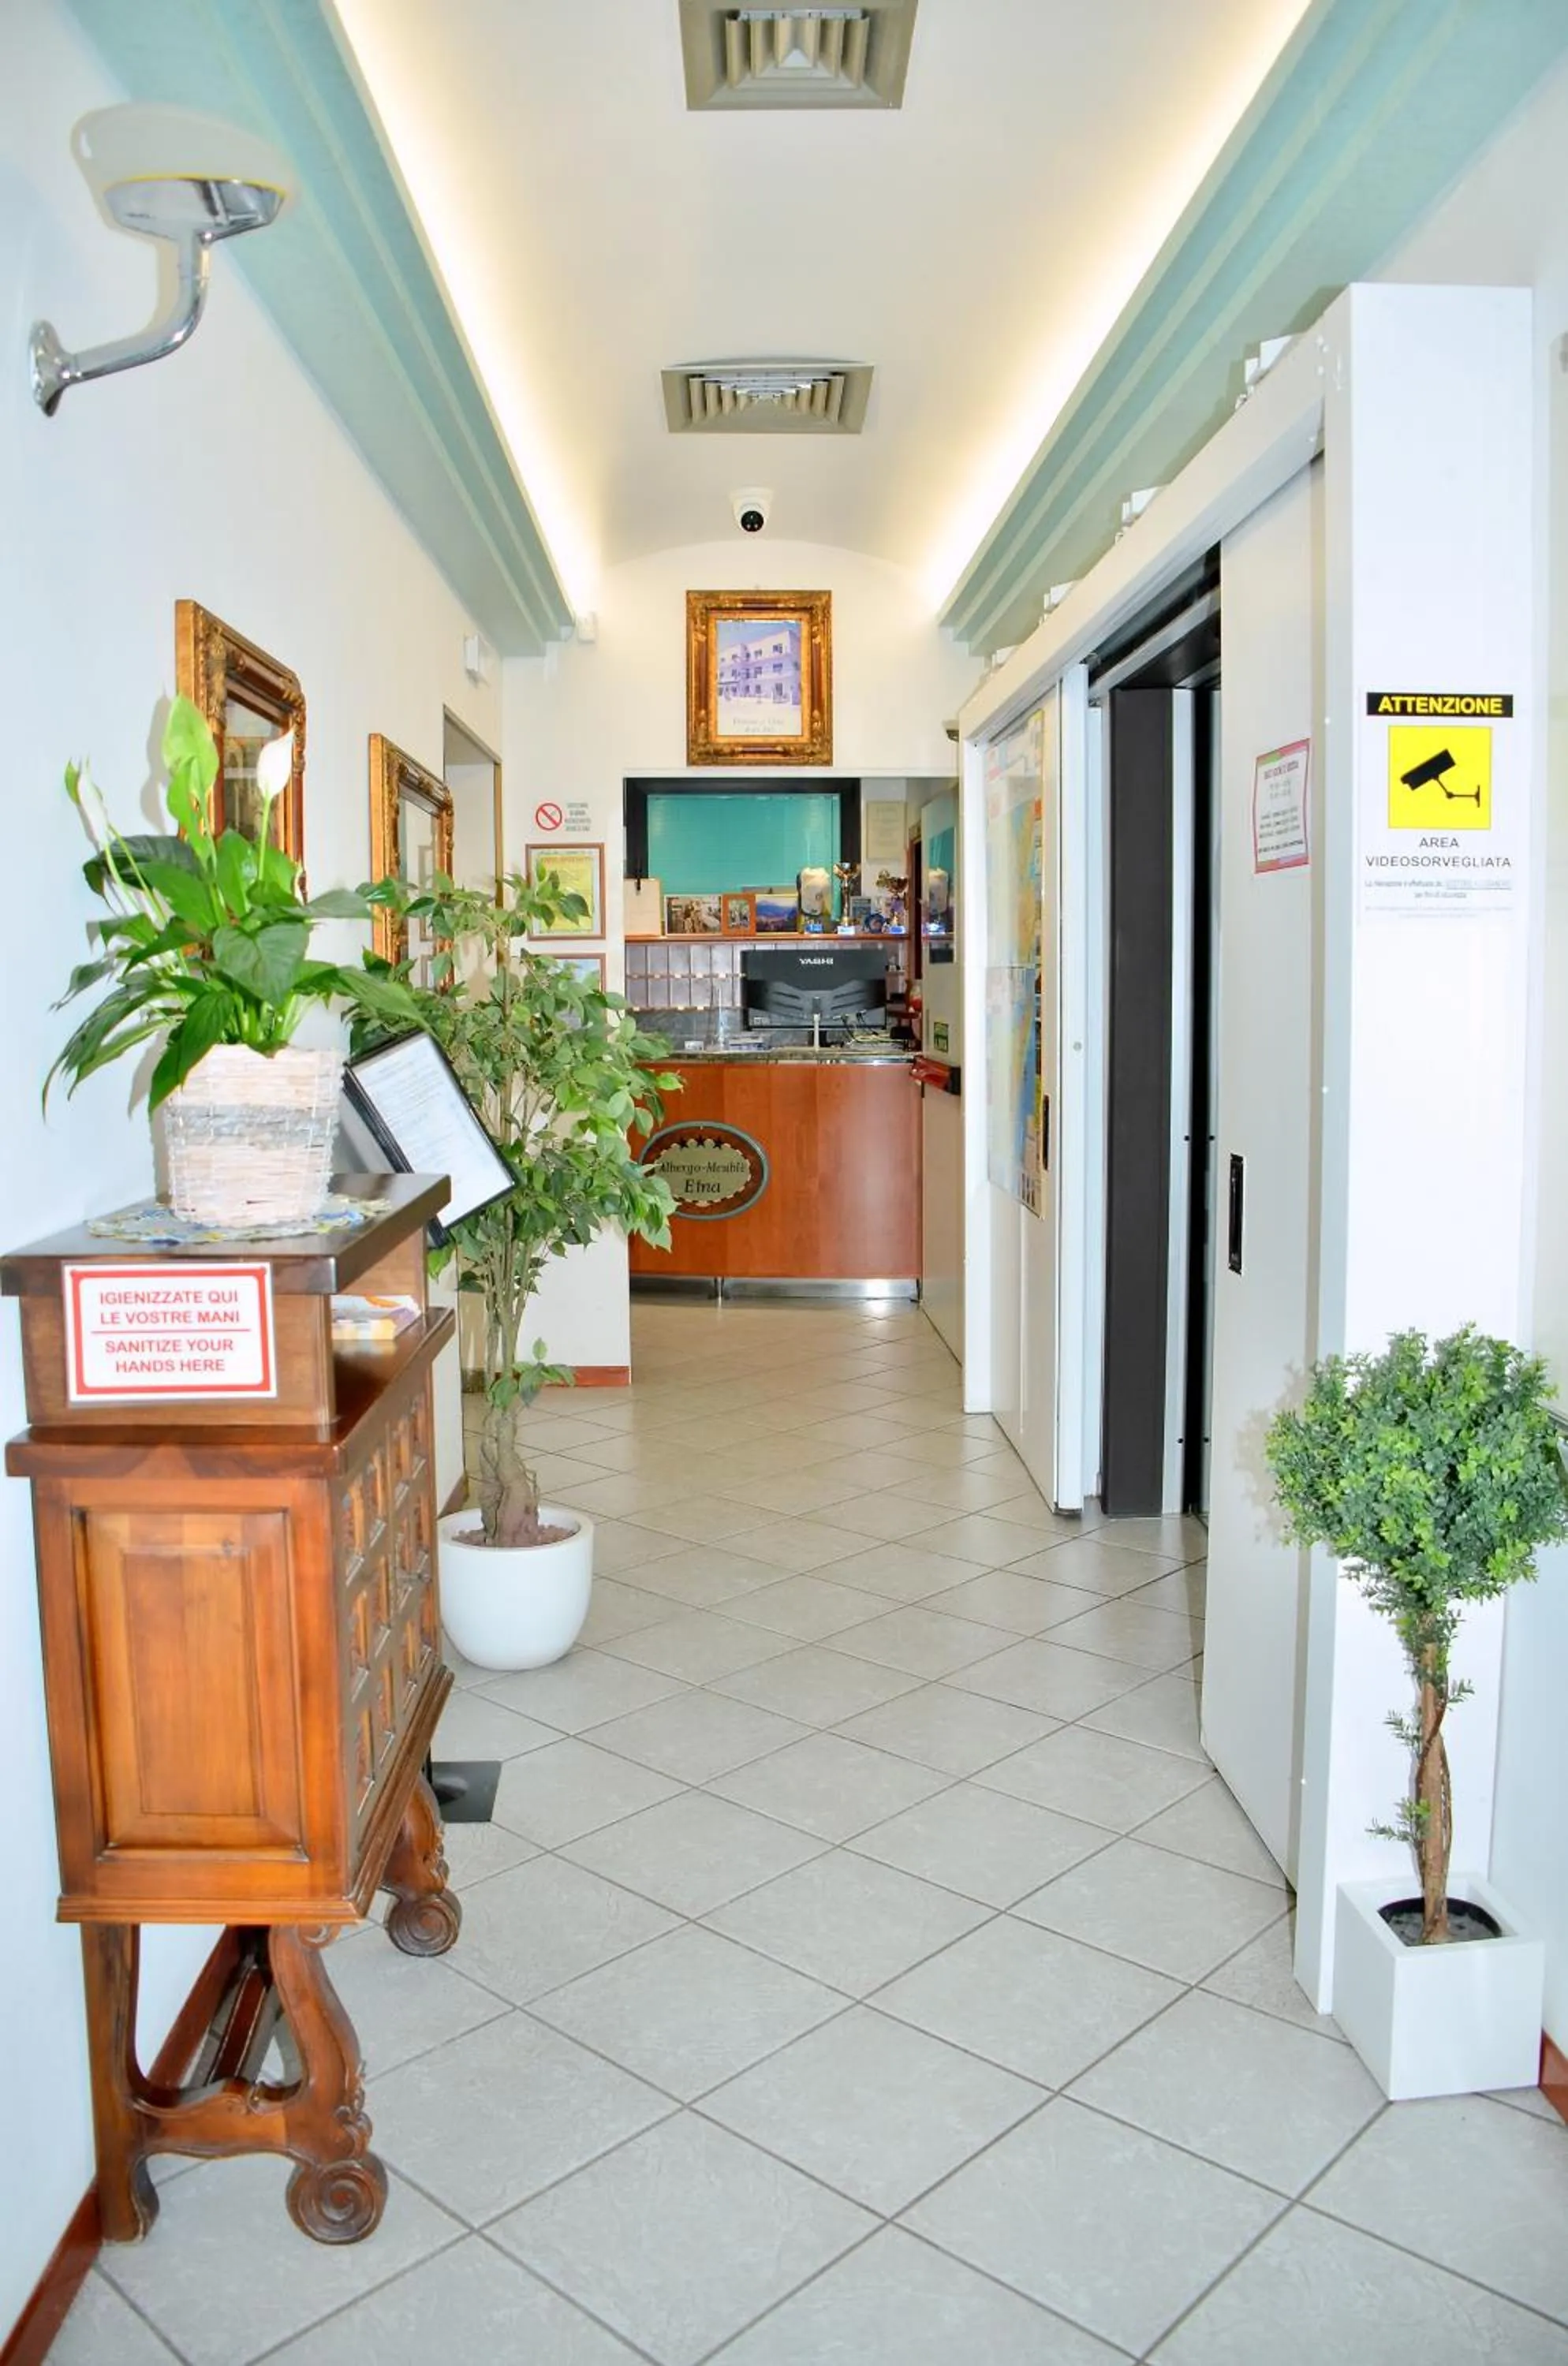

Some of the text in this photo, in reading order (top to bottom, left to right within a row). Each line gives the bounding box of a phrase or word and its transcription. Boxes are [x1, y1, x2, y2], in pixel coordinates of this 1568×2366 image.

[1378, 696, 1503, 715] ATTENZIONE
[1419, 837, 1460, 849] AREA
[1365, 856, 1512, 868] VIDEOSORVEGLIATA
[684, 1179, 721, 1193] Etna
[99, 1289, 238, 1304] IGIENIZZATE QUI
[100, 1310, 240, 1325] LE VOSTRE MANI
[105, 1339, 233, 1353] SANITIZE YOUR
[115, 1359, 226, 1373] HANDS HERE
